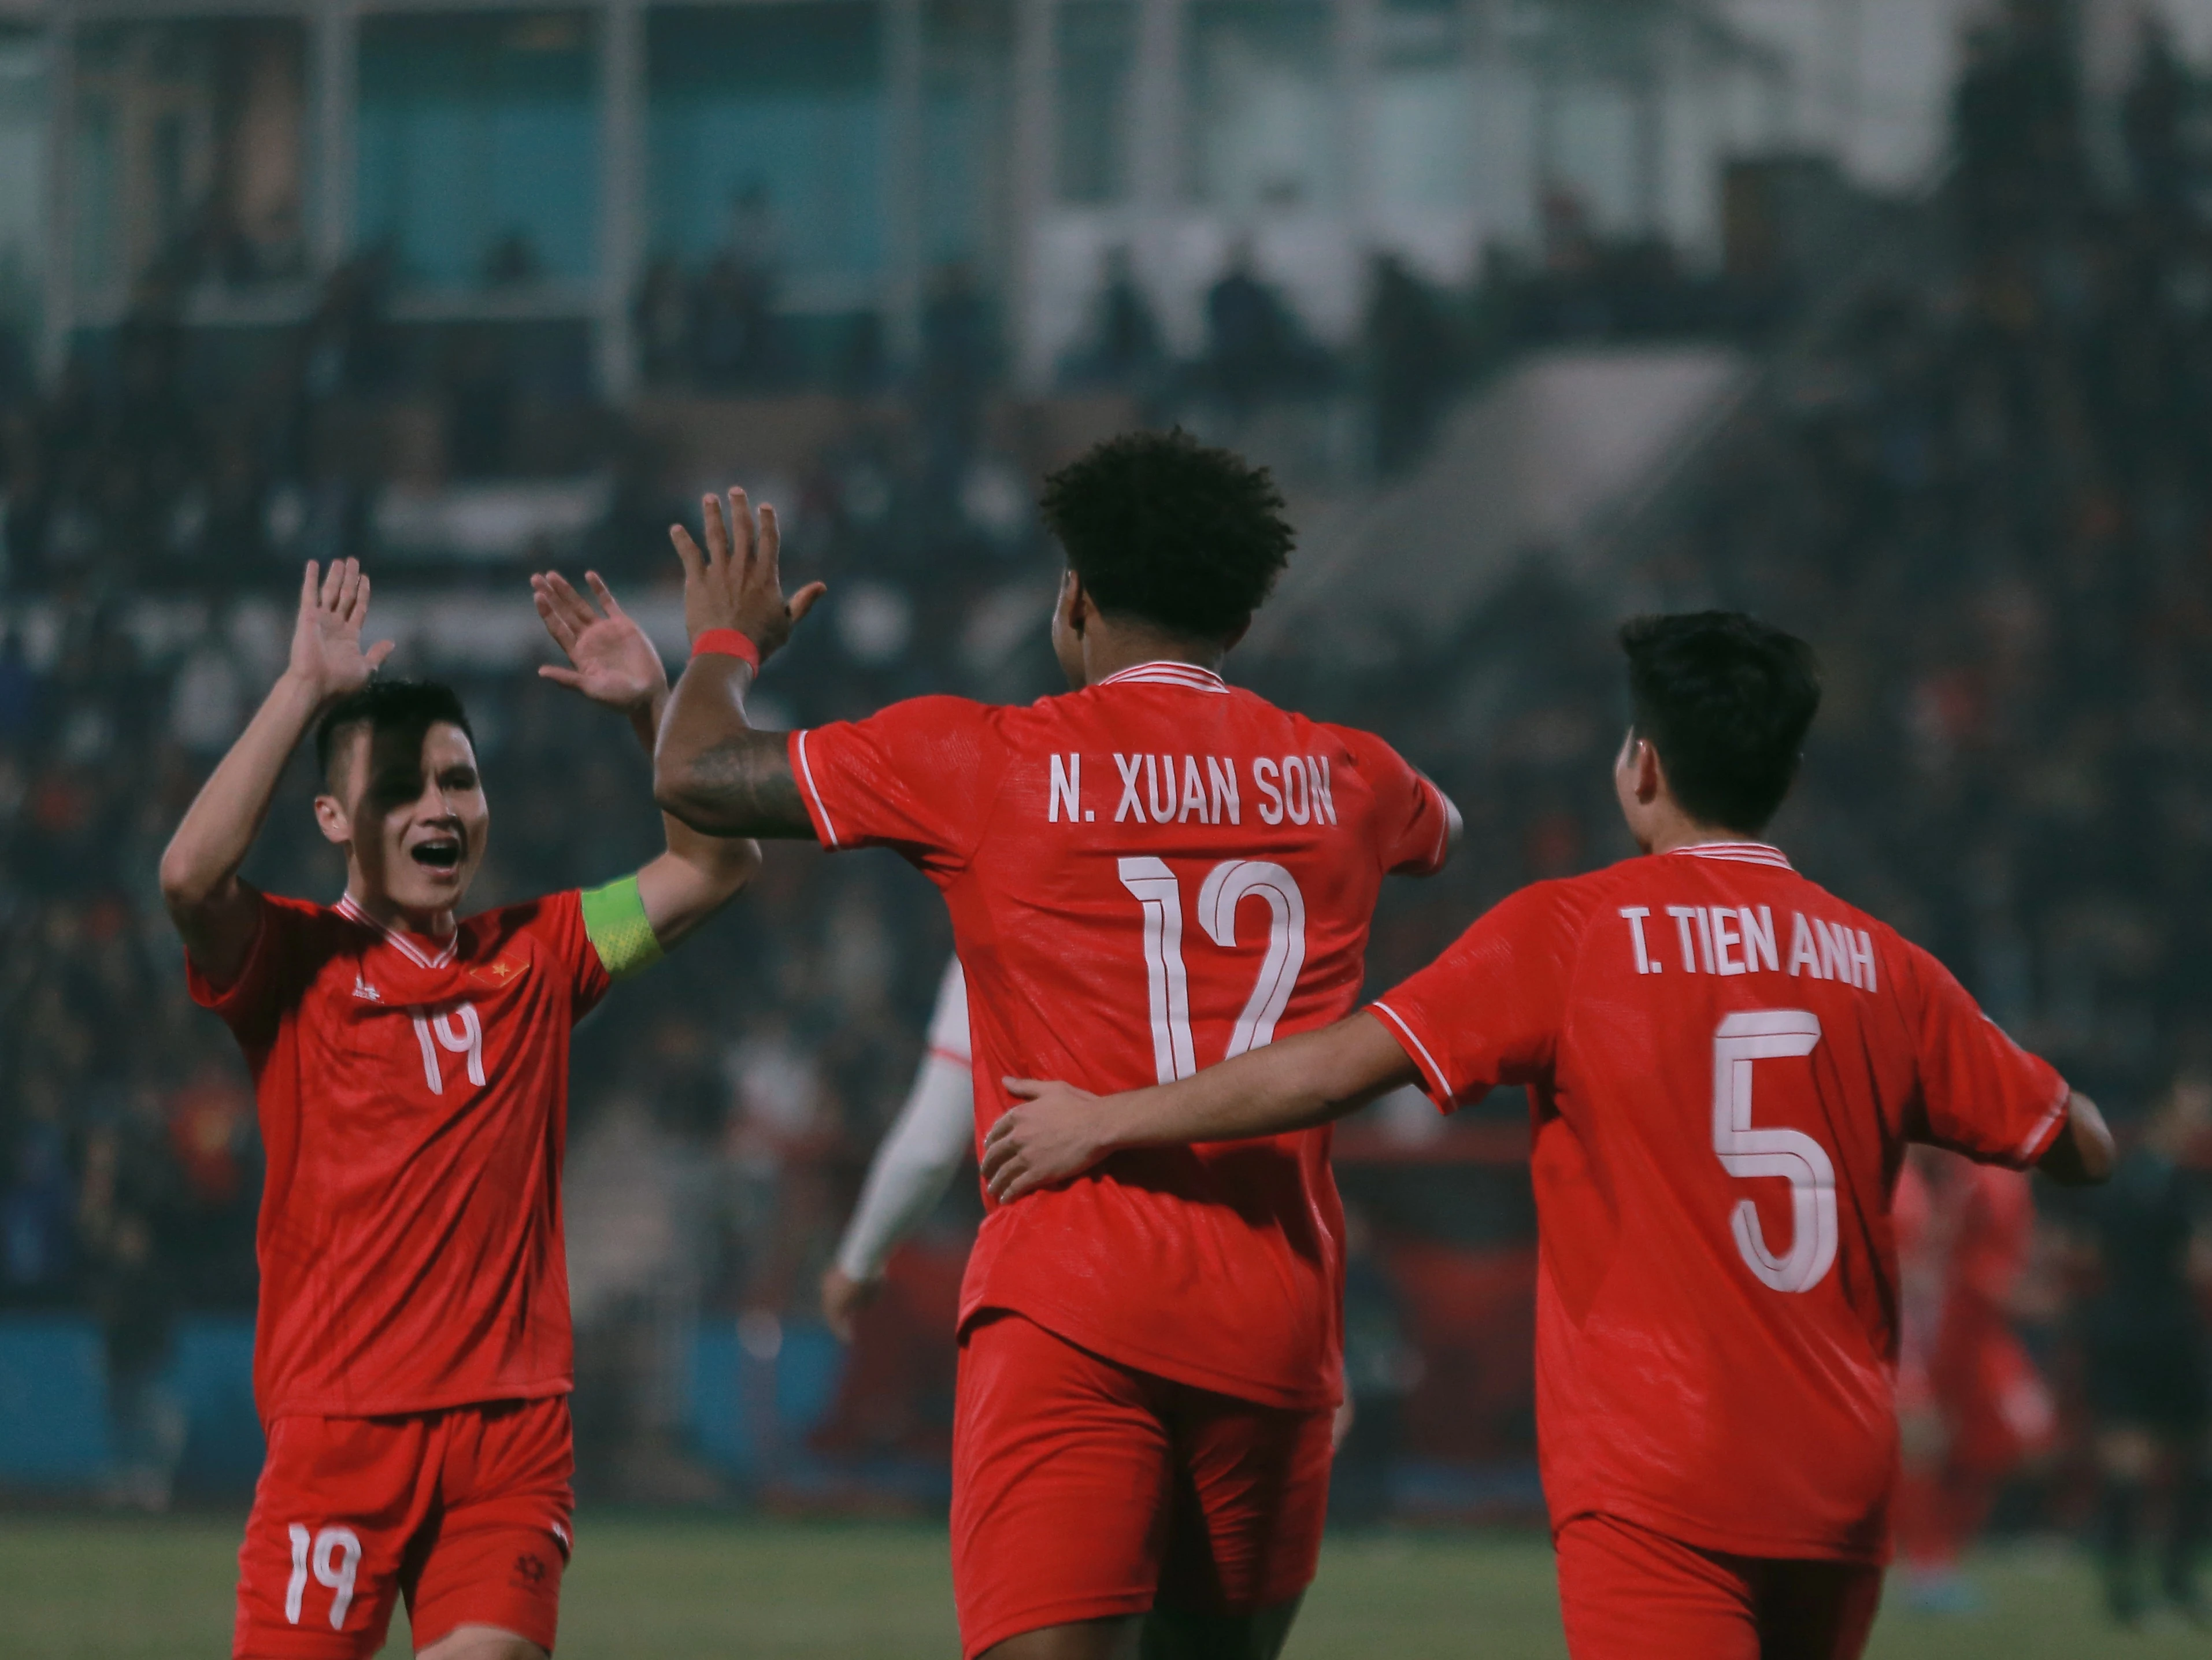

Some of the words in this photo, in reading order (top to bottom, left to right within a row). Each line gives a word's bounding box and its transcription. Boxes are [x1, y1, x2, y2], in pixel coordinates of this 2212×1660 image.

[1048, 753, 1095, 823] N.
[1113, 753, 1240, 825] XUAN
[1253, 755, 1337, 825] SON
[1620, 906, 1662, 974] T.
[1668, 905, 1780, 976] TIEN
[1788, 912, 1877, 993] ANH
[407, 1002, 486, 1095] 19
[1713, 1010, 1839, 1293] 5
[285, 1522, 362, 1631] 19
